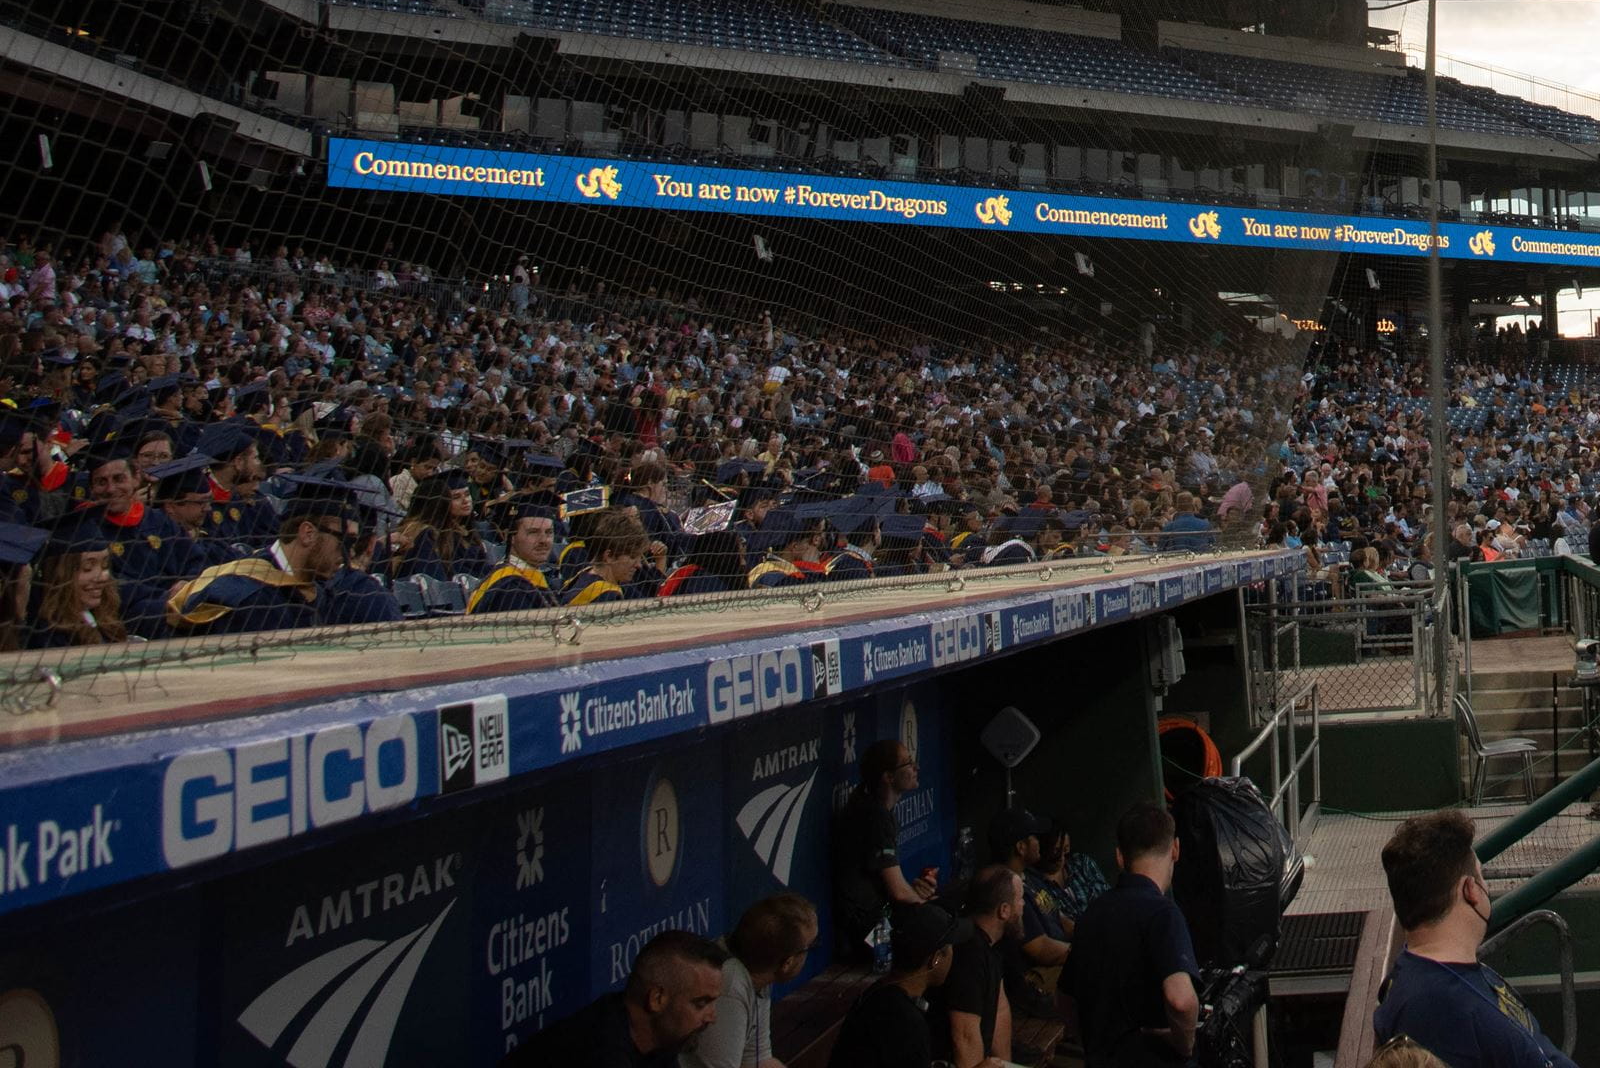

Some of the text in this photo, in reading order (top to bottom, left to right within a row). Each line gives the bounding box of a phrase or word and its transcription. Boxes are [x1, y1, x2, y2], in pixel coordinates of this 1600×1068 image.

[354, 151, 545, 187] Commencement
[653, 174, 692, 198] You
[699, 183, 731, 200] are
[735, 185, 779, 203] now
[784, 185, 947, 218] #ForeverDragons
[1035, 202, 1168, 229] Commencement
[1242, 217, 1271, 236] You
[1274, 225, 1297, 239] are
[1300, 227, 1331, 240] now
[1334, 226, 1449, 252] #ForeverDragons
[932, 614, 981, 668] GEICO
[1053, 594, 1083, 633] GEICO
[874, 636, 926, 672] Citizens Bank Park
[585, 678, 694, 737] Citizens Bank Park
[706, 647, 803, 724] GEICO
[480, 713, 503, 742] NEW
[481, 739, 504, 769] ERA
[751, 737, 820, 782] AMTRAK
[162, 712, 419, 870] GEICO
[38, 804, 113, 883] Park
[653, 807, 672, 858] R
[286, 851, 457, 948] AMTRAK
[487, 906, 570, 976] Citizens
[502, 965, 552, 1031] Bank
